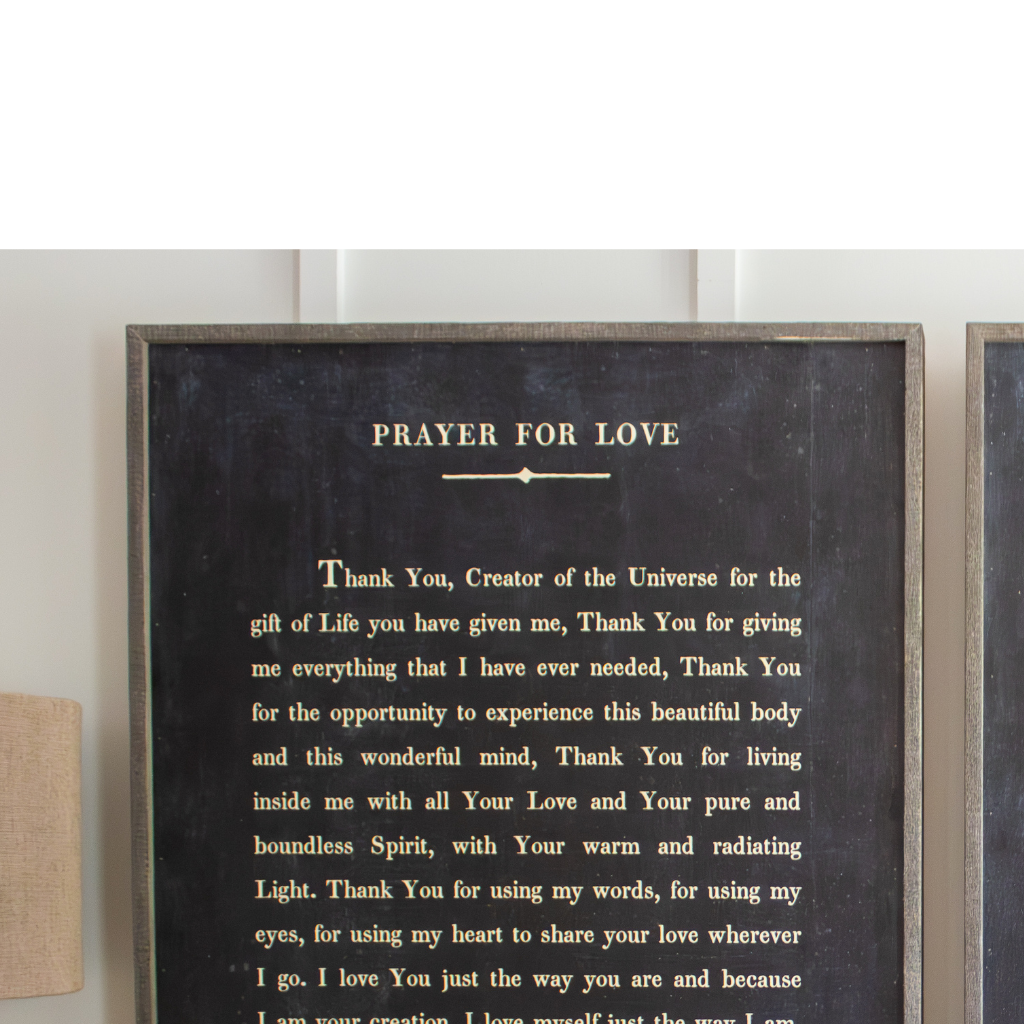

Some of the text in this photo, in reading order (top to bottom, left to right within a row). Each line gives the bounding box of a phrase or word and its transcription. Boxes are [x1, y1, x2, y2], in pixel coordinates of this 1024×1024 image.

[371, 421, 680, 447] PRAYER FOR LOVE
[317, 559, 802, 592] Thank You, Creator of the Universe for the
[251, 656, 802, 684] me everything that I have ever needed, Thank You
[252, 745, 802, 772] and this wonderful mind, Thank You for living
[253, 834, 802, 861] boundless Spirit, with Your warm and radiating
[255, 923, 803, 950] eyes, for using my heart to share your love wherever
